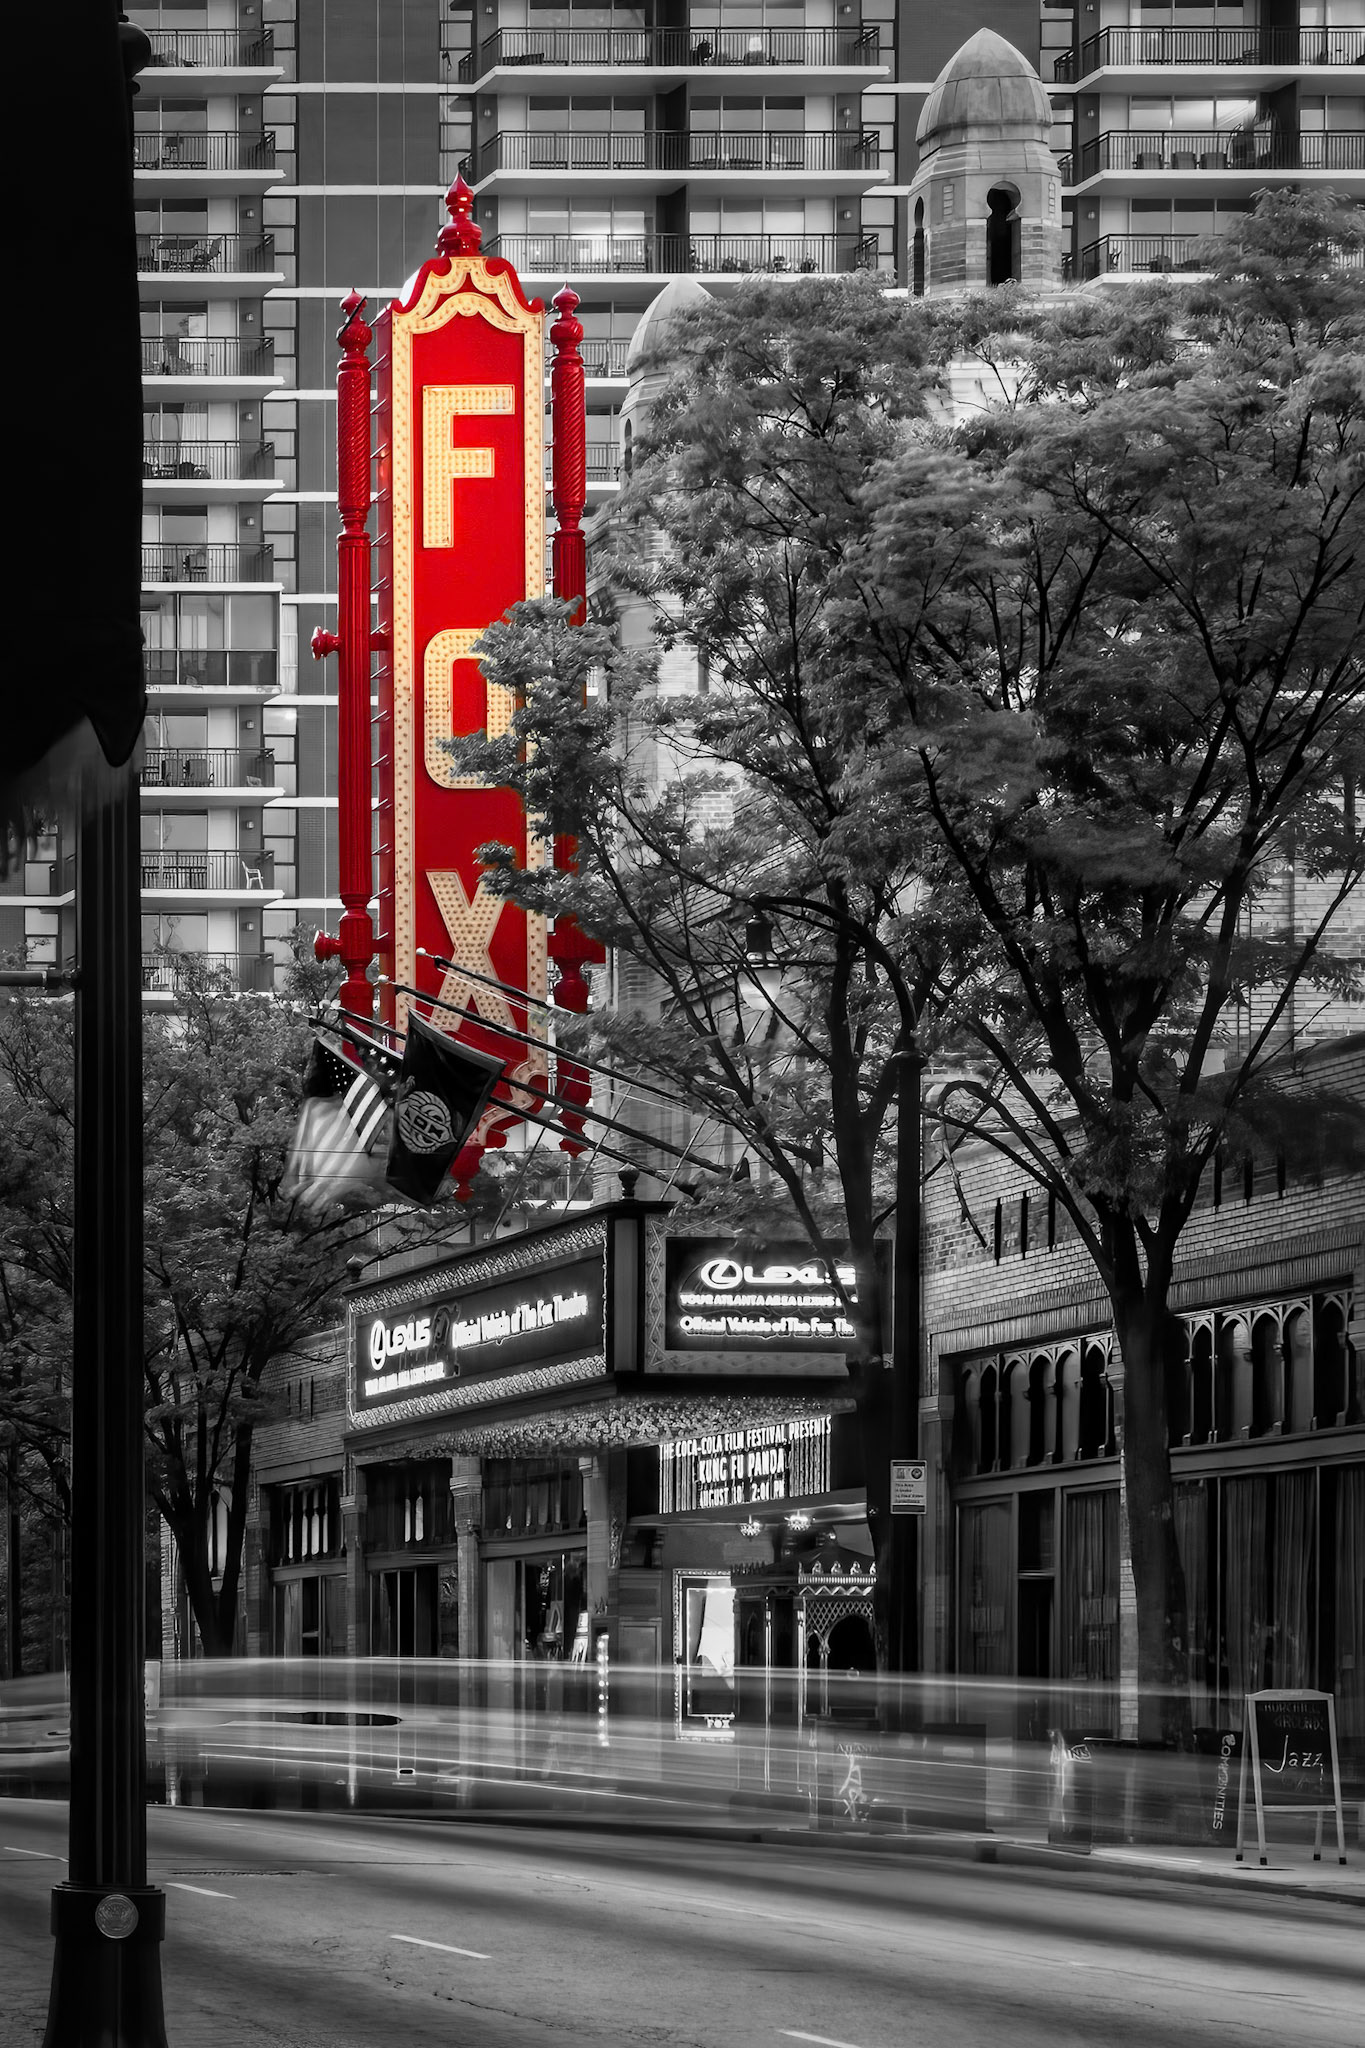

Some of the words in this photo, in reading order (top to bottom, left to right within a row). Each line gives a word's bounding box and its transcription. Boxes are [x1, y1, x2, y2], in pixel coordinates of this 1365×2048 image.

[422, 384, 516, 1032] FOX
[386, 1318, 430, 1356] LEXUS
[659, 1442, 675, 1459] THE
[675, 1434, 723, 1458] COCA-COLA
[724, 1431, 745, 1452] FILM
[789, 1414, 832, 1441] PRESENTS
[699, 1457, 727, 1483] KUNG
[731, 1454, 744, 1480] FU
[748, 1448, 784, 1477] PANDA
[700, 1487, 729, 1509] AUGUST
[707, 1719, 730, 1729] FOX
